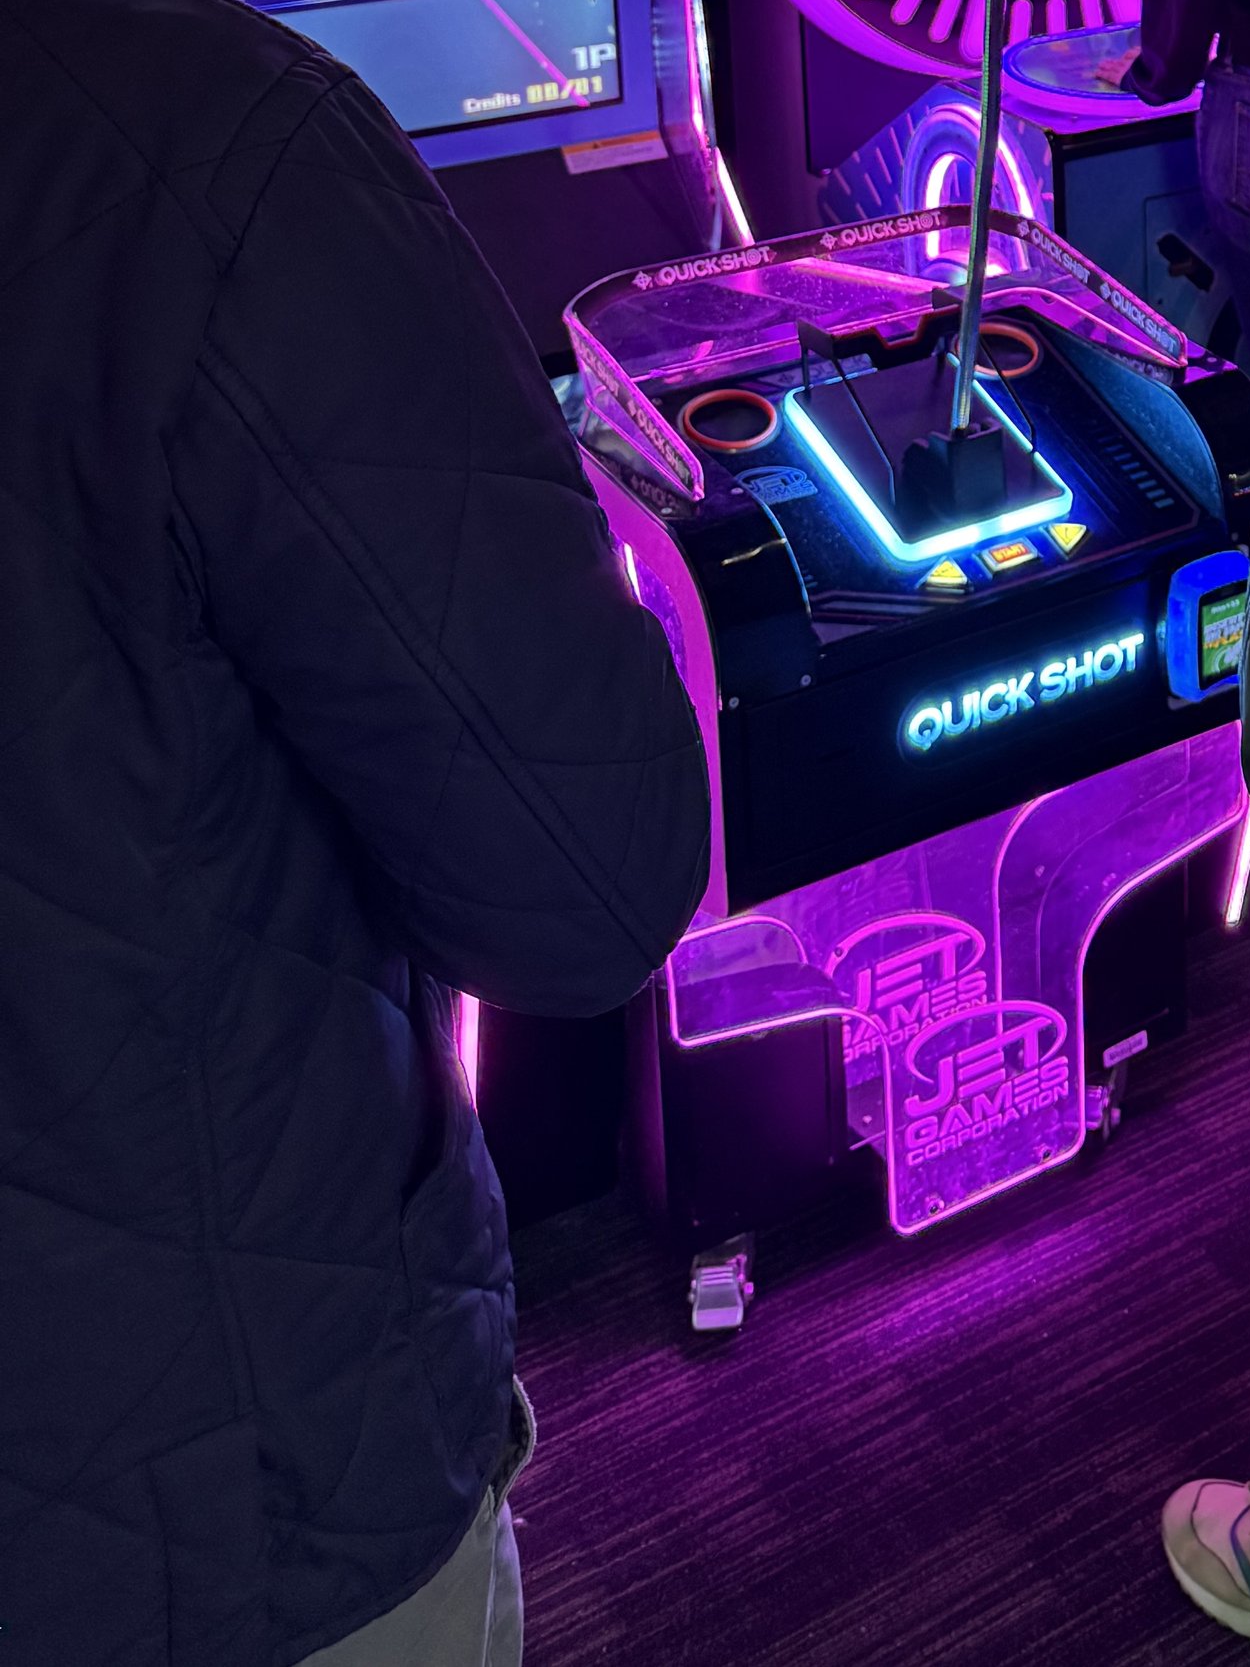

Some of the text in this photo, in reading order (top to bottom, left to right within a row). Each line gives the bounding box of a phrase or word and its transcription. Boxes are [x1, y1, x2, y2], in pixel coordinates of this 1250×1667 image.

[572, 43, 616, 71] 1P
[462, 92, 521, 114] Credits
[840, 211, 942, 246] QUICK SHOT
[660, 245, 770, 285] QUICK SHOT
[908, 632, 1145, 751] QUICK SHOT
[904, 1015, 1054, 1117] JET
[904, 1056, 1070, 1149] GAMES
[906, 1080, 1070, 1166] CORPORATION
